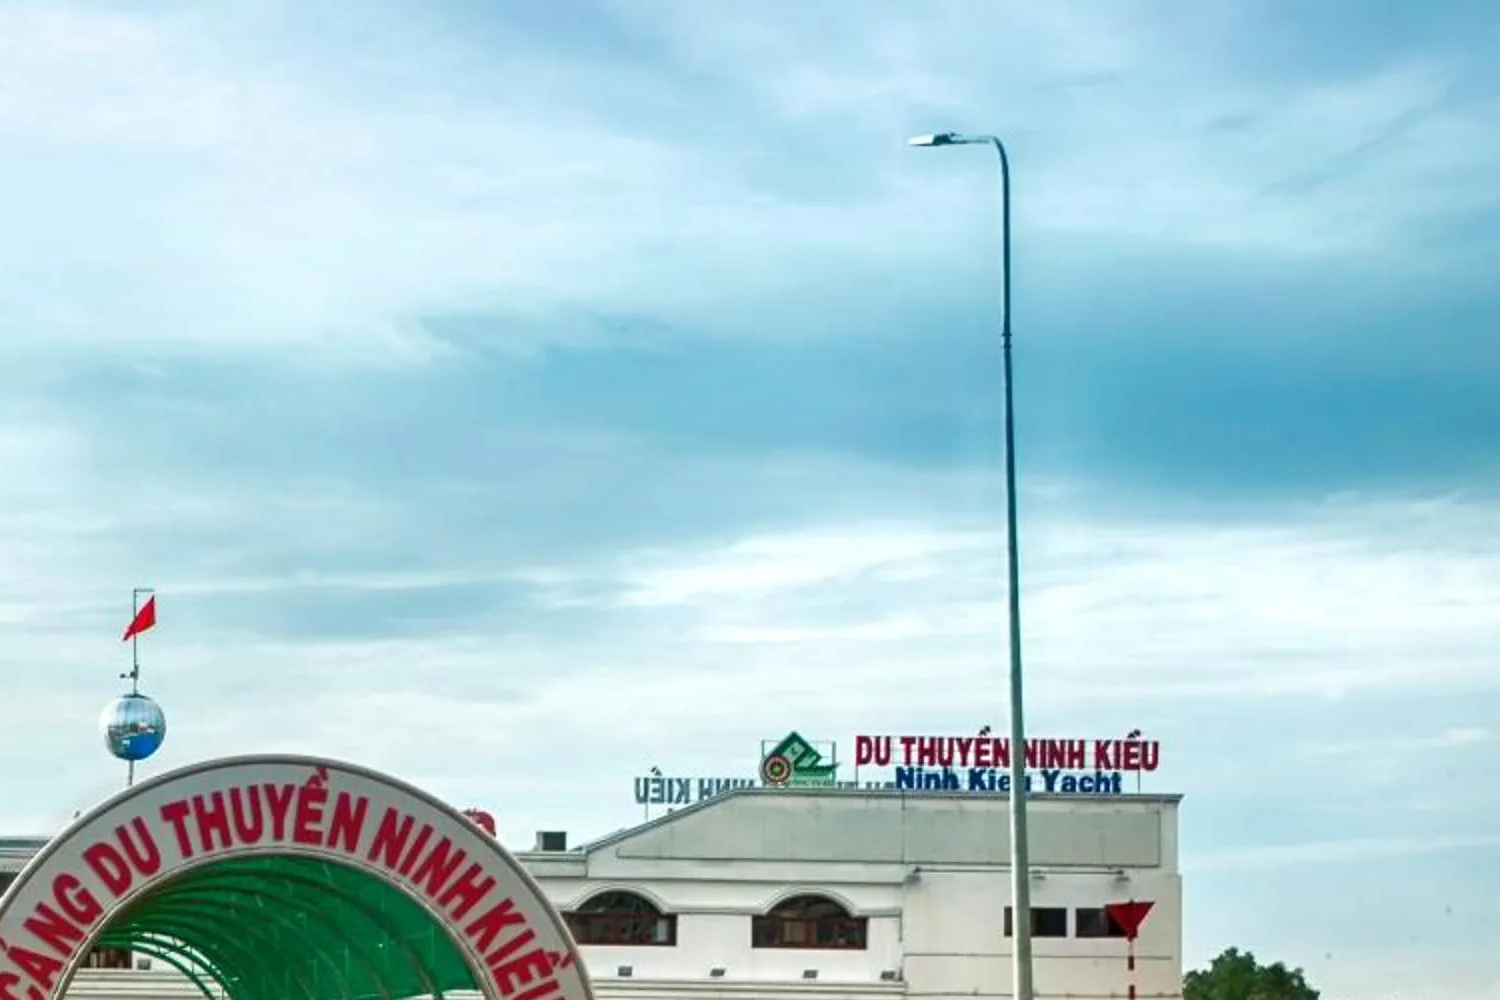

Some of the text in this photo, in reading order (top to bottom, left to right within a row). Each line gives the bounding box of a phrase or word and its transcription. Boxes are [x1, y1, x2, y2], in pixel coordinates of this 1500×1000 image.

[855, 735, 891, 767] DU
[1023, 738, 1086, 769] NINH
[895, 766, 959, 790] Ninh
[1041, 769, 1122, 793] Yacht
[83, 816, 162, 896] DU
[160, 767, 370, 858] THUYỀN
[369, 810, 497, 922] NINH
